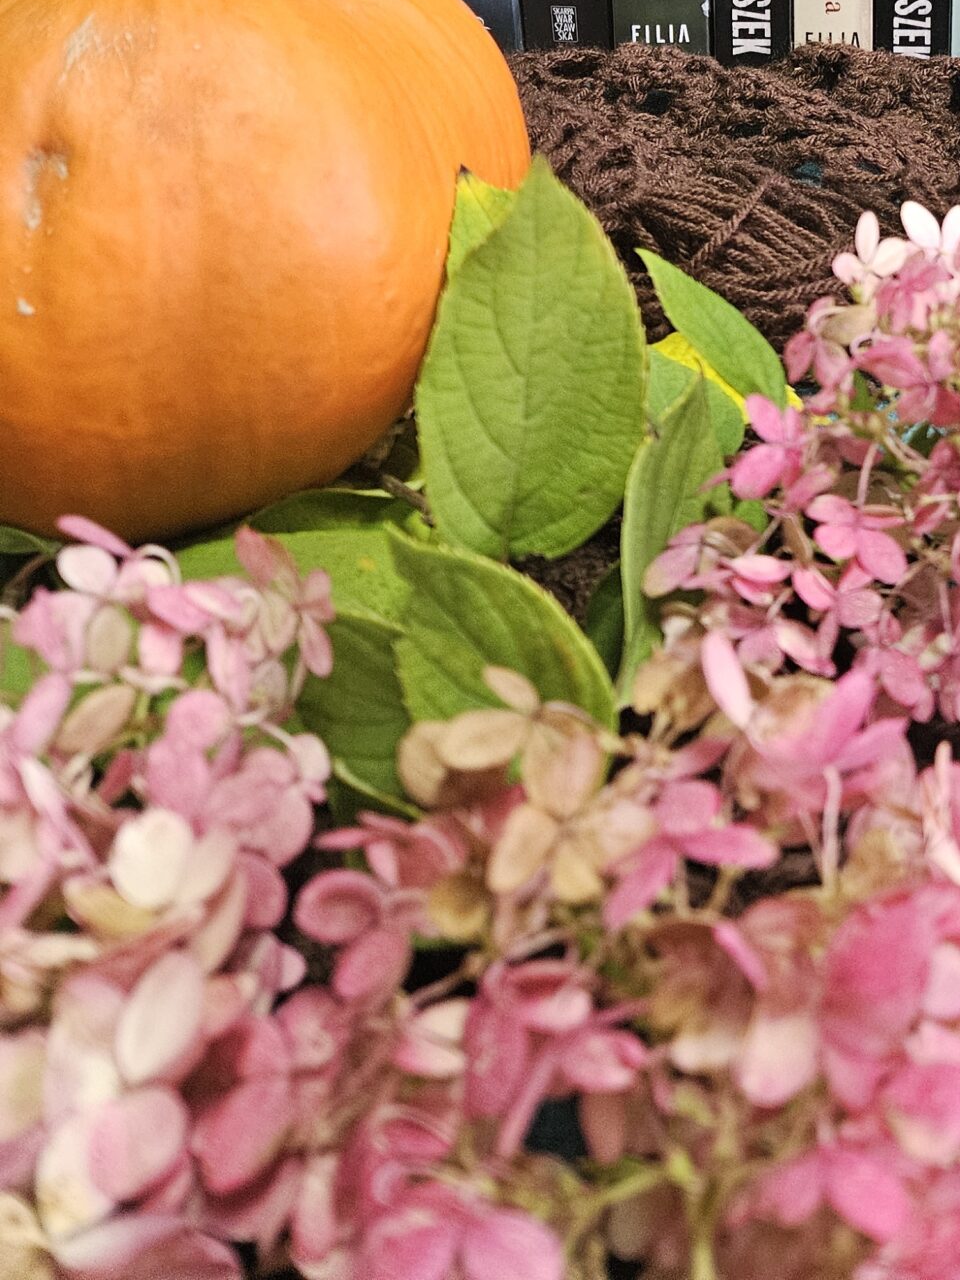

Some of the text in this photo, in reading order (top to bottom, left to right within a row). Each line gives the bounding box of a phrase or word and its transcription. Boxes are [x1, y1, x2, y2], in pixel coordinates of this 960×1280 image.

[552, 7, 575, 15] SKARPA
[555, 14, 573, 24] WAR
[554, 23, 576, 33] SZAW
[557, 32, 574, 41] SKA
[631, 23, 690, 44] FILIA
